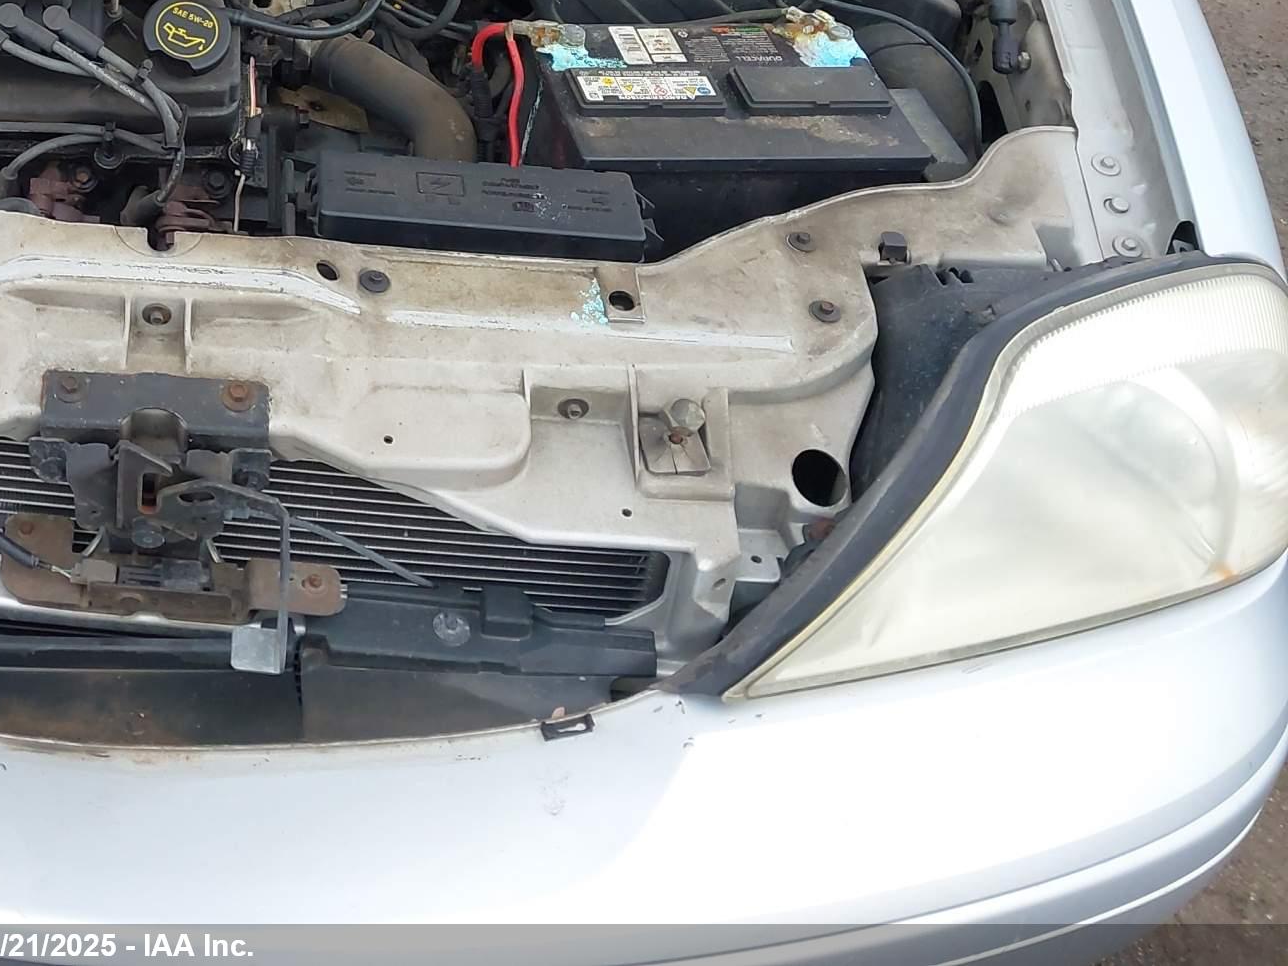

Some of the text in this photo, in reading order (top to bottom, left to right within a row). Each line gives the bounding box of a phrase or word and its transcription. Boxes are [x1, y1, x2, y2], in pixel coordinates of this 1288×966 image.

[172, 7, 214, 29] SAE 5W-20
[735, 54, 783, 62] DURACELL
